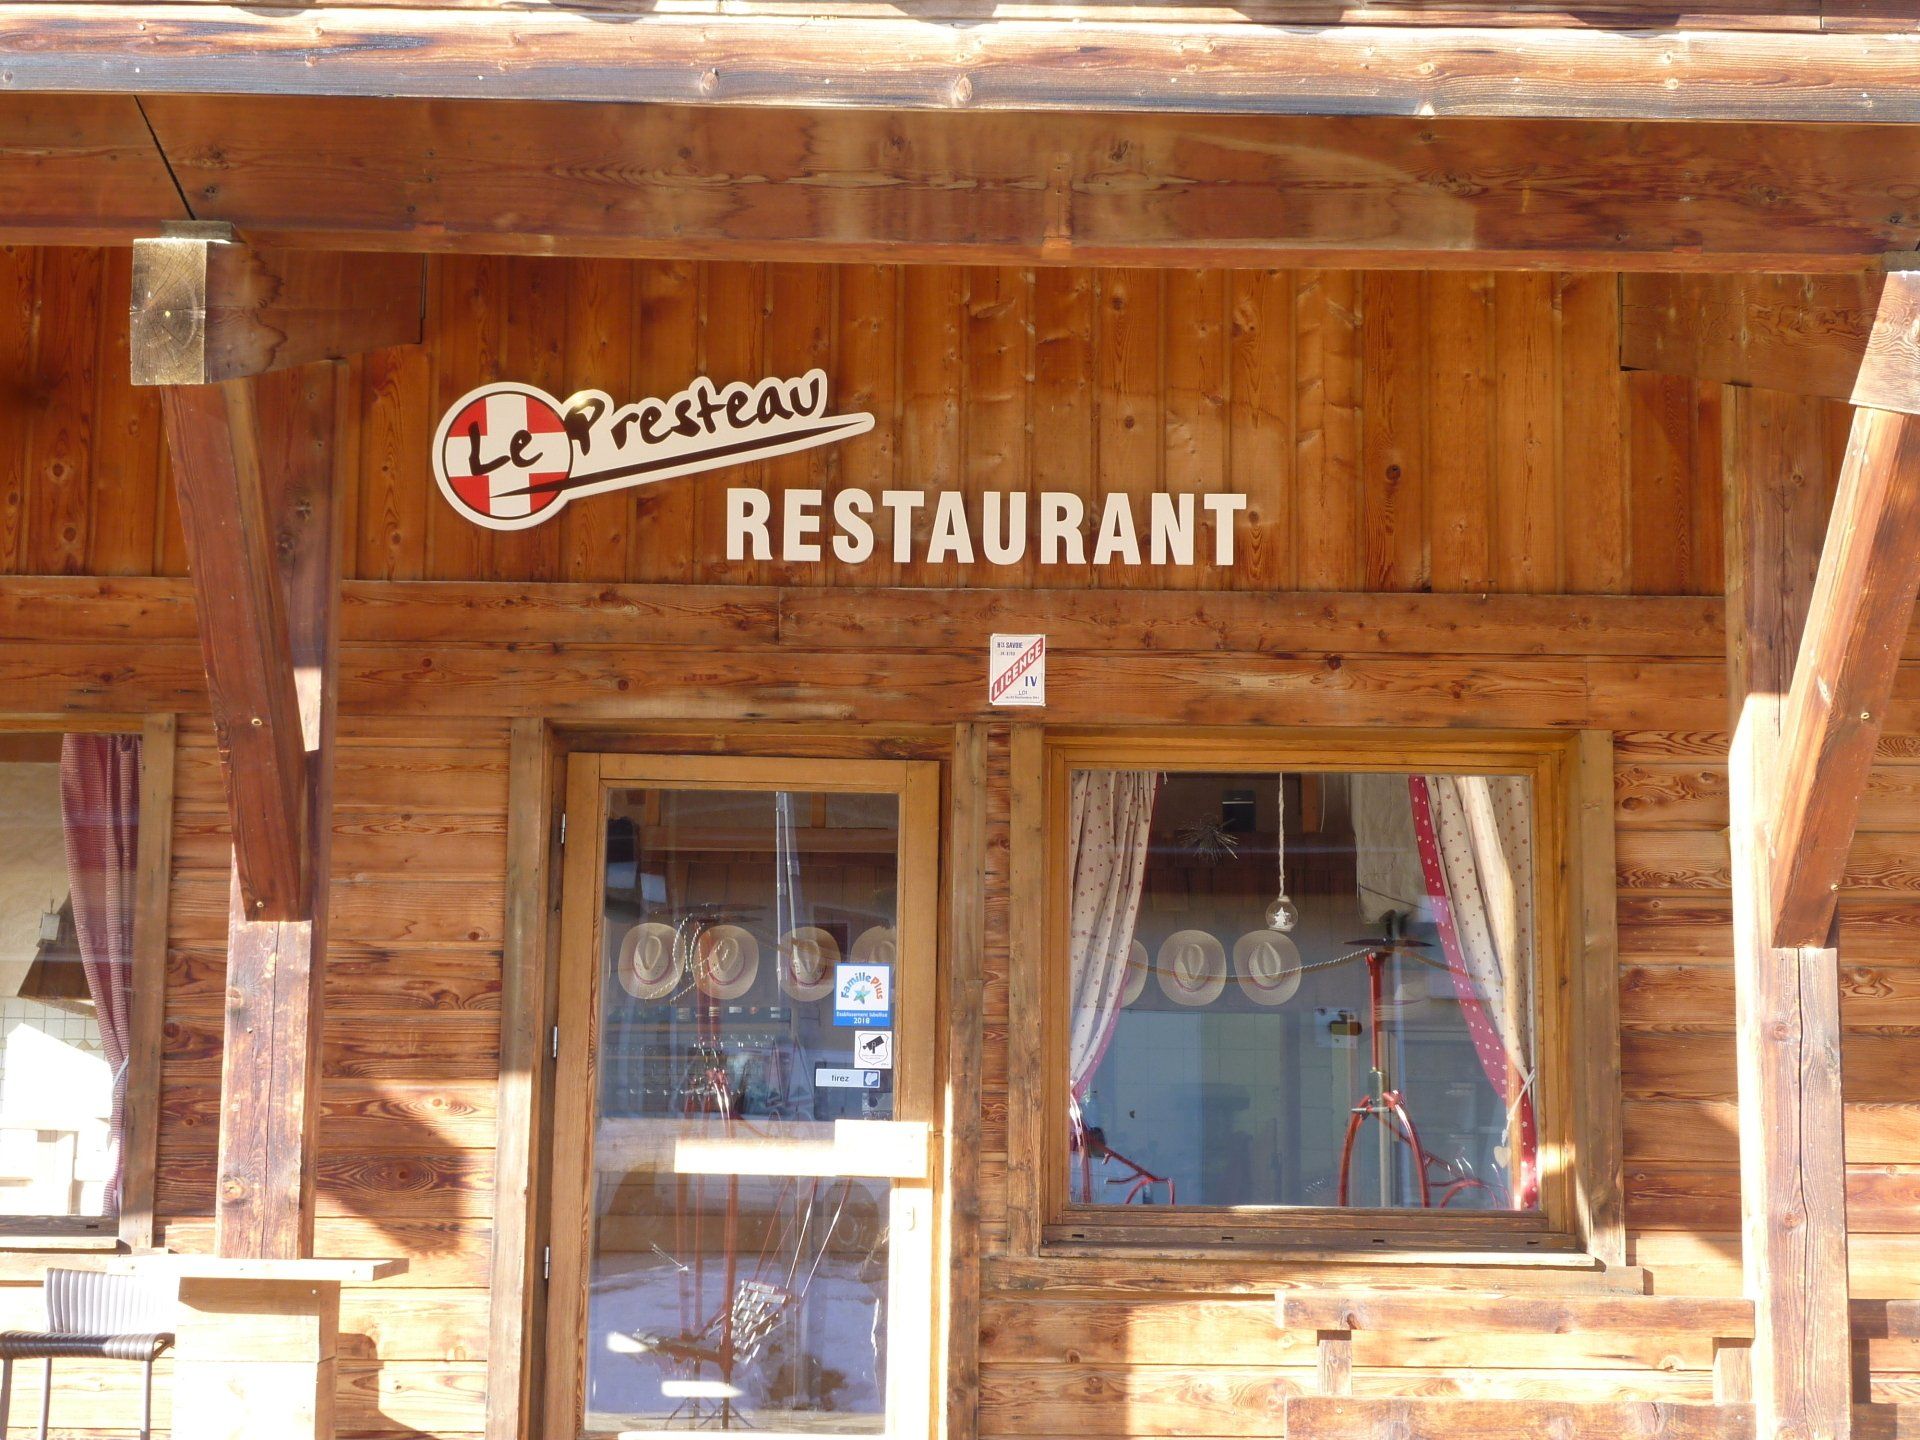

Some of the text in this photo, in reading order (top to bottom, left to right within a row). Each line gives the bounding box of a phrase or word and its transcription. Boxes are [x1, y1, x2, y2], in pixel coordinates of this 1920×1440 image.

[468, 377, 821, 476] Le Presteau
[726, 487, 1247, 566] RESTAURANT
[994, 641, 1041, 695] LICENCE
[1025, 675, 1038, 687] IV
[840, 971, 883, 1000] Famille Plus
[831, 1074, 850, 1083] tirez
